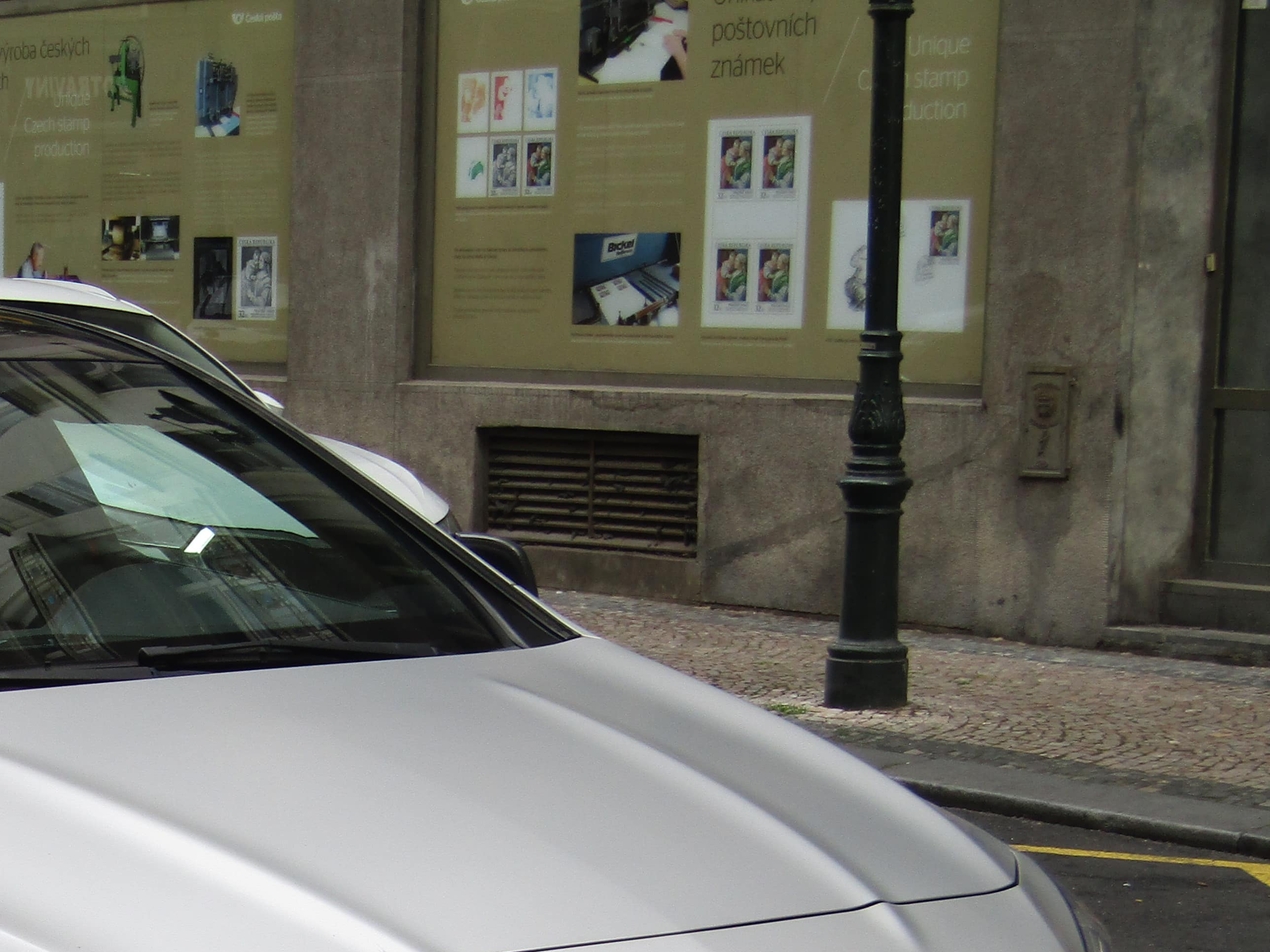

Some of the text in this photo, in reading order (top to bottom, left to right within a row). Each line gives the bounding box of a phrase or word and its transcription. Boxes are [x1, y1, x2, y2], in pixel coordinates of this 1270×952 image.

[711, 12, 817, 48] poštovních
[39, 36, 90, 60] českých
[907, 35, 971, 59] Unique
[710, 52, 786, 79] známek
[914, 69, 969, 91] stamp
[53, 91, 91, 108] Unique
[24, 117, 91, 134] Czech stamp
[34, 140, 90, 159] production
